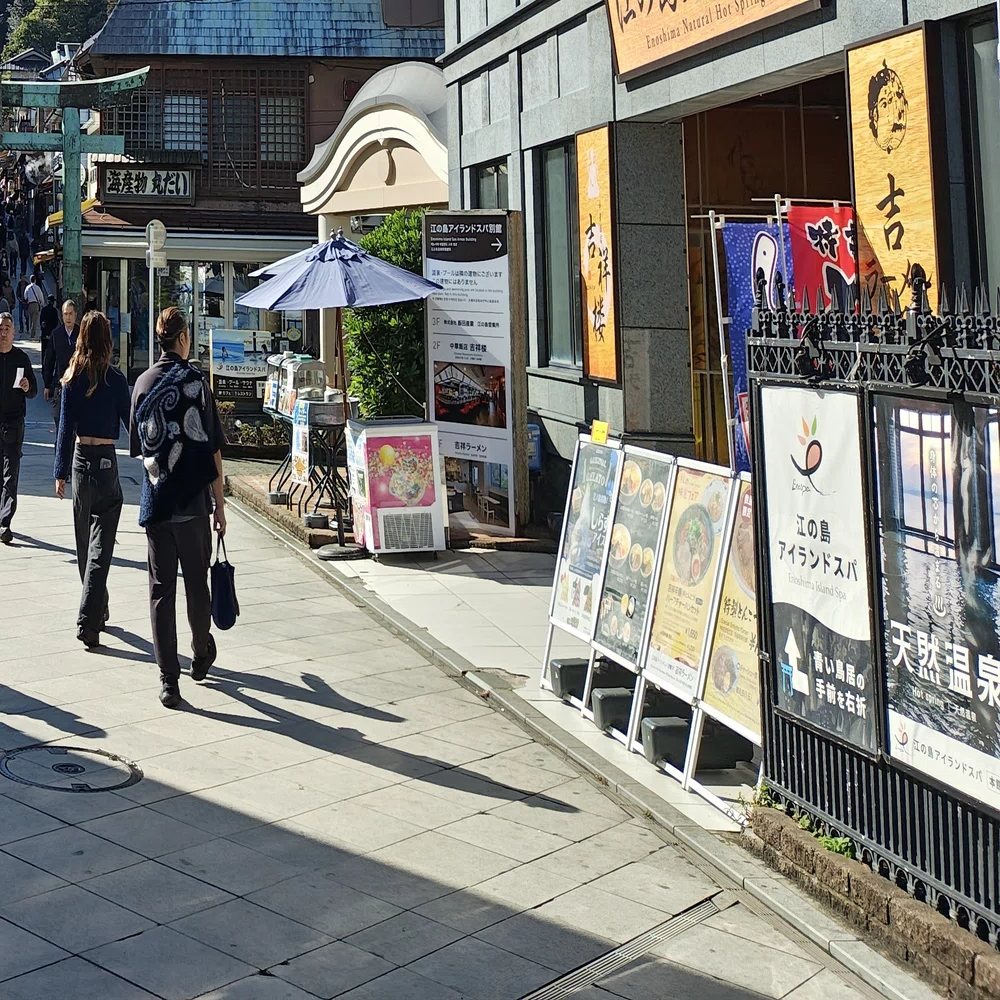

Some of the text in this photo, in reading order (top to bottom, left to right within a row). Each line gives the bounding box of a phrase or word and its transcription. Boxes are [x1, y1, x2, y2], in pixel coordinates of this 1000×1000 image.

[645, 25, 681, 50] Enoshima
[682, 6, 713, 35] Natural
[714, 2, 732, 21] Hot
[107, 168, 188, 195] 海産物 丸だい
[430, 223, 503, 234] 江の島アイランドスパ別館
[432, 317, 440, 326] 3F
[432, 341, 441, 350] 2F
[225, 364, 266, 372] 江の島アイランドスパ
[454, 441, 488, 453] 吉祥ラーメン
[796, 513, 831, 544] 江の島
[778, 540, 858, 582] アイランドスパ
[788, 572, 847, 603] Enoshima Island Spa
[812, 650, 866, 691] 青い鳥居の
[890, 619, 1000, 708] 天然温泉
[815, 677, 867, 720] 手前を右折
[912, 738, 983, 783] 江の島アイランドスパ
